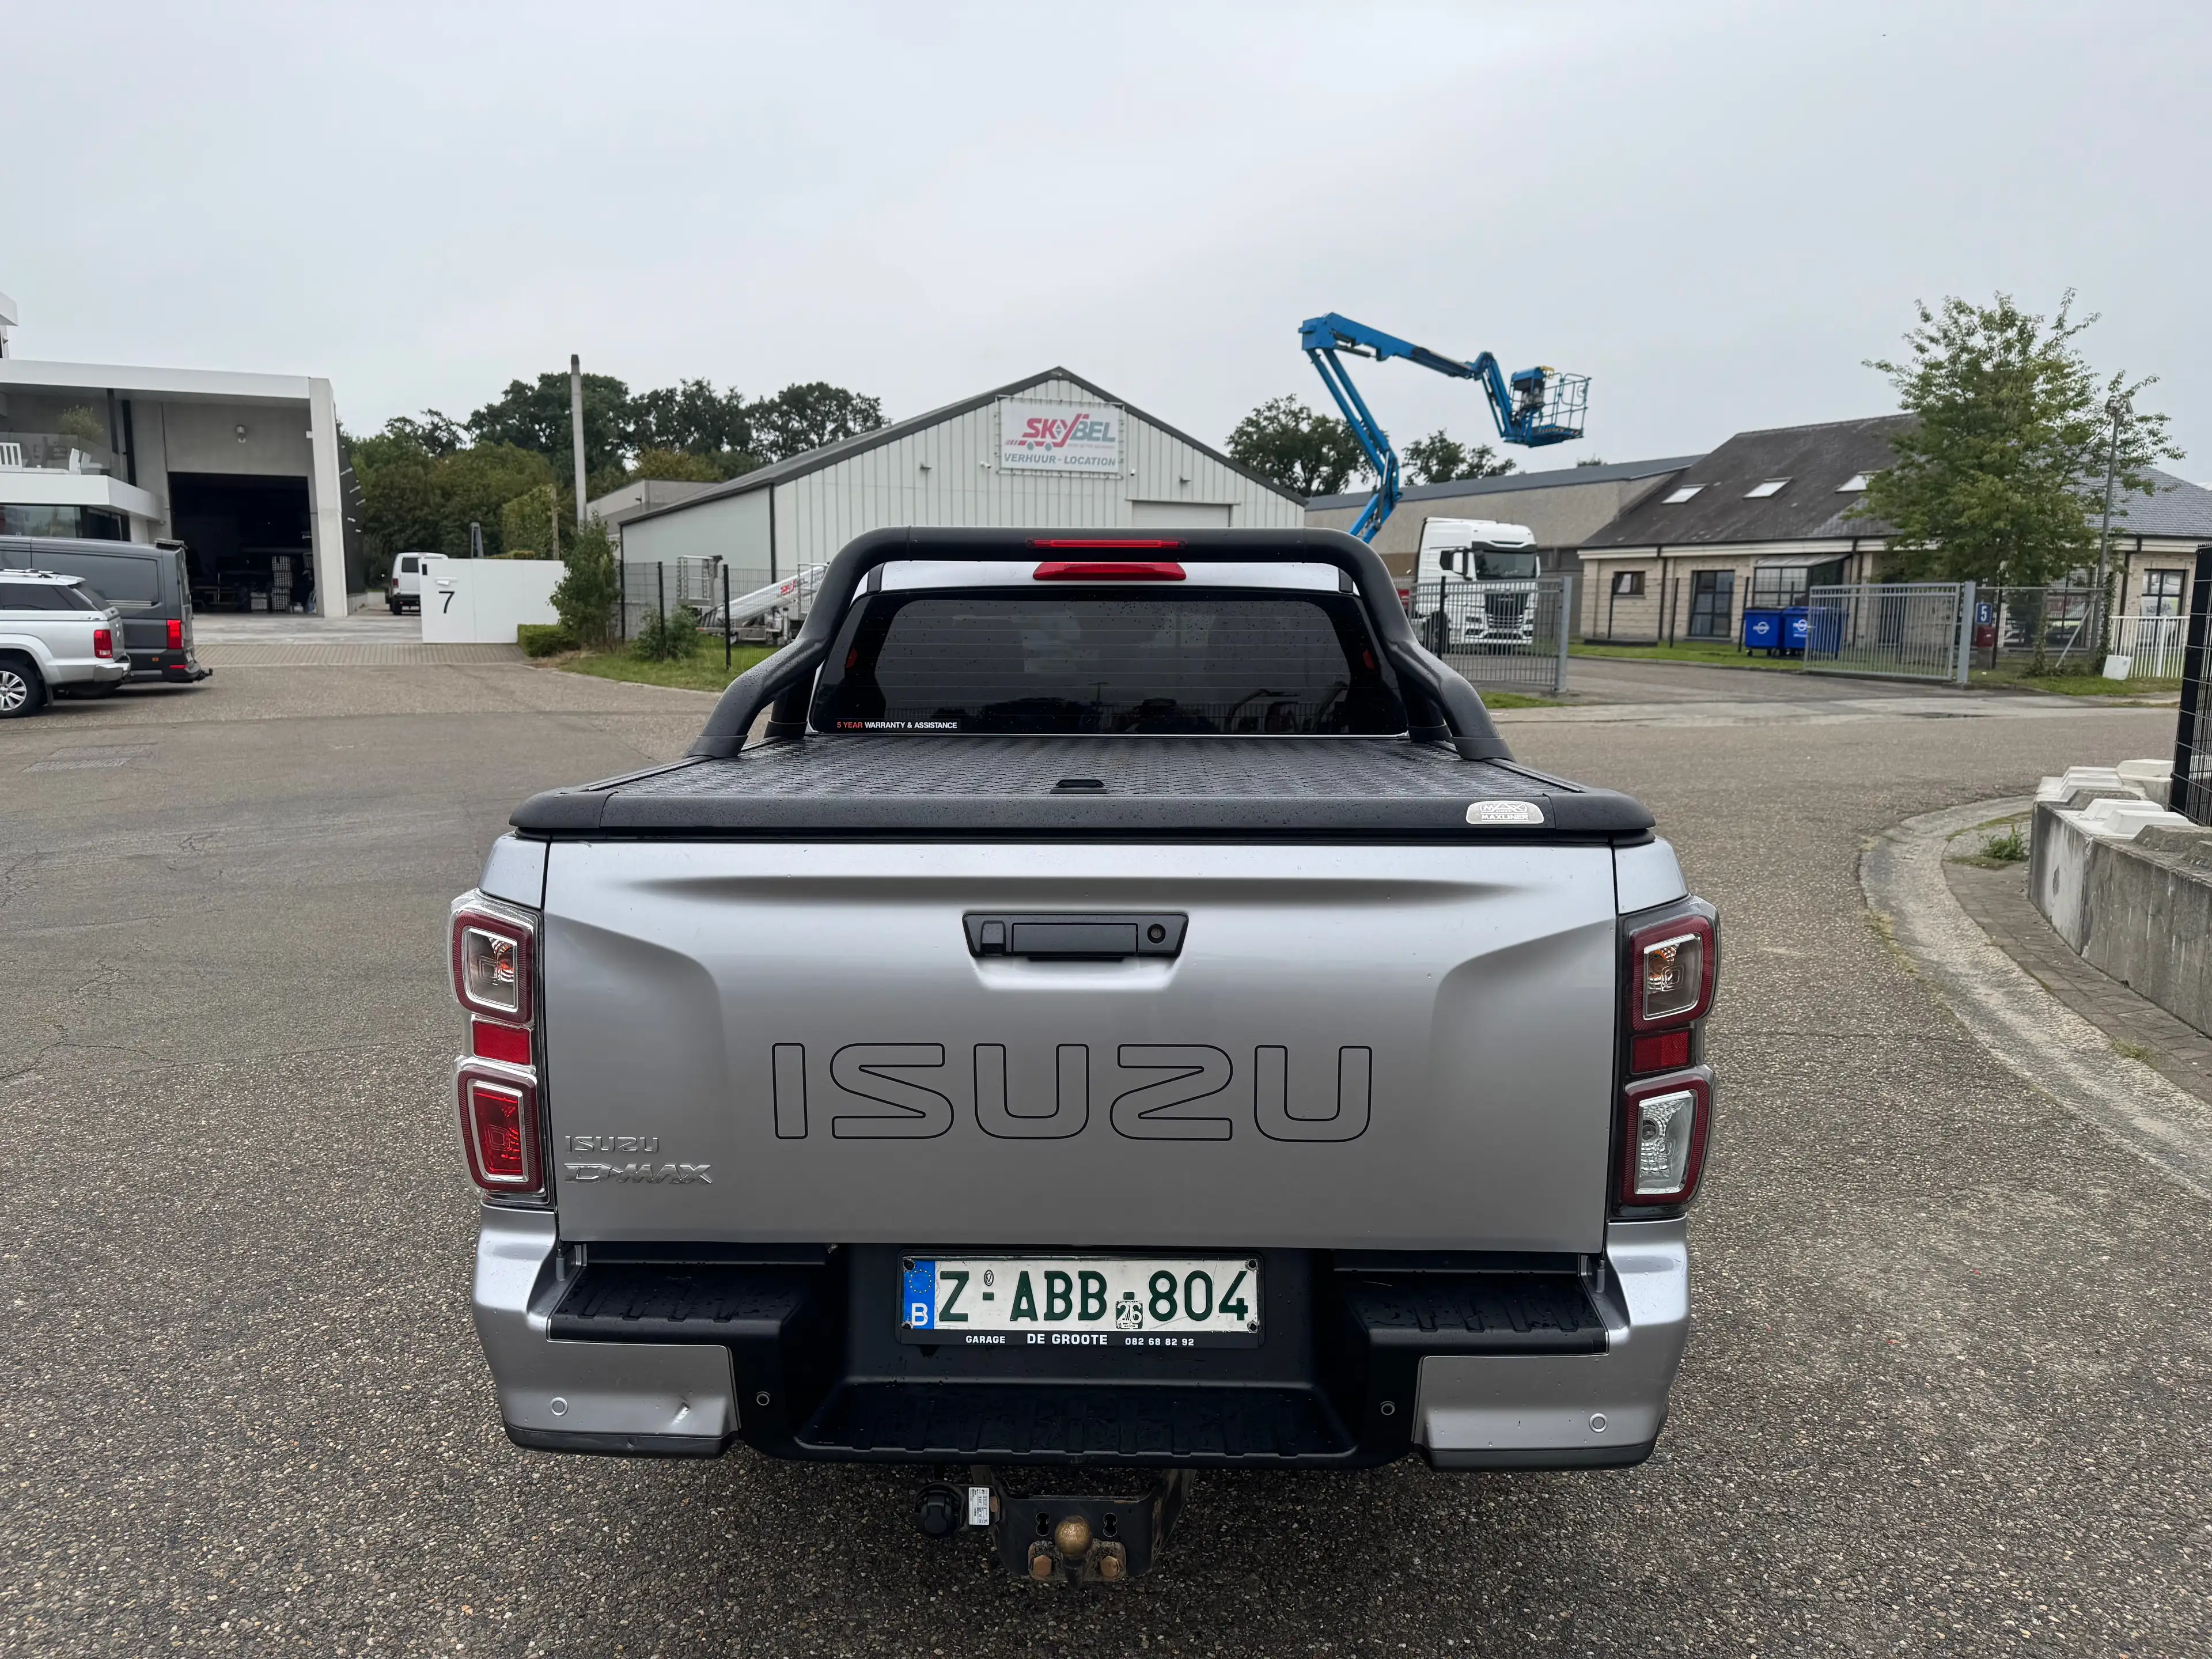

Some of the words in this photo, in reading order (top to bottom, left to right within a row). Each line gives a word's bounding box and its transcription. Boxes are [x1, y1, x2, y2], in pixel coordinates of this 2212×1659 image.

[1022, 414, 1116, 448] SKYBEL
[1005, 453, 1056, 464] VERHUUR
[1064, 455, 1116, 466] LOCATION
[438, 590, 455, 614] 7
[1980, 605, 1987, 622] 5
[772, 1043, 1373, 1142] ISUZU
[565, 1135, 659, 1153] ISUZU
[911, 1302, 929, 1326] B
[965, 1335, 1006, 1344] GARAGE
[1027, 1334, 1046, 1344] DE
[1051, 1334, 1108, 1346] GROOTE
[1124, 1337, 1144, 1346] 082
[1148, 1337, 1161, 1346] 68
[1165, 1337, 1178, 1346] 82
[1181, 1338, 1195, 1346] 92
